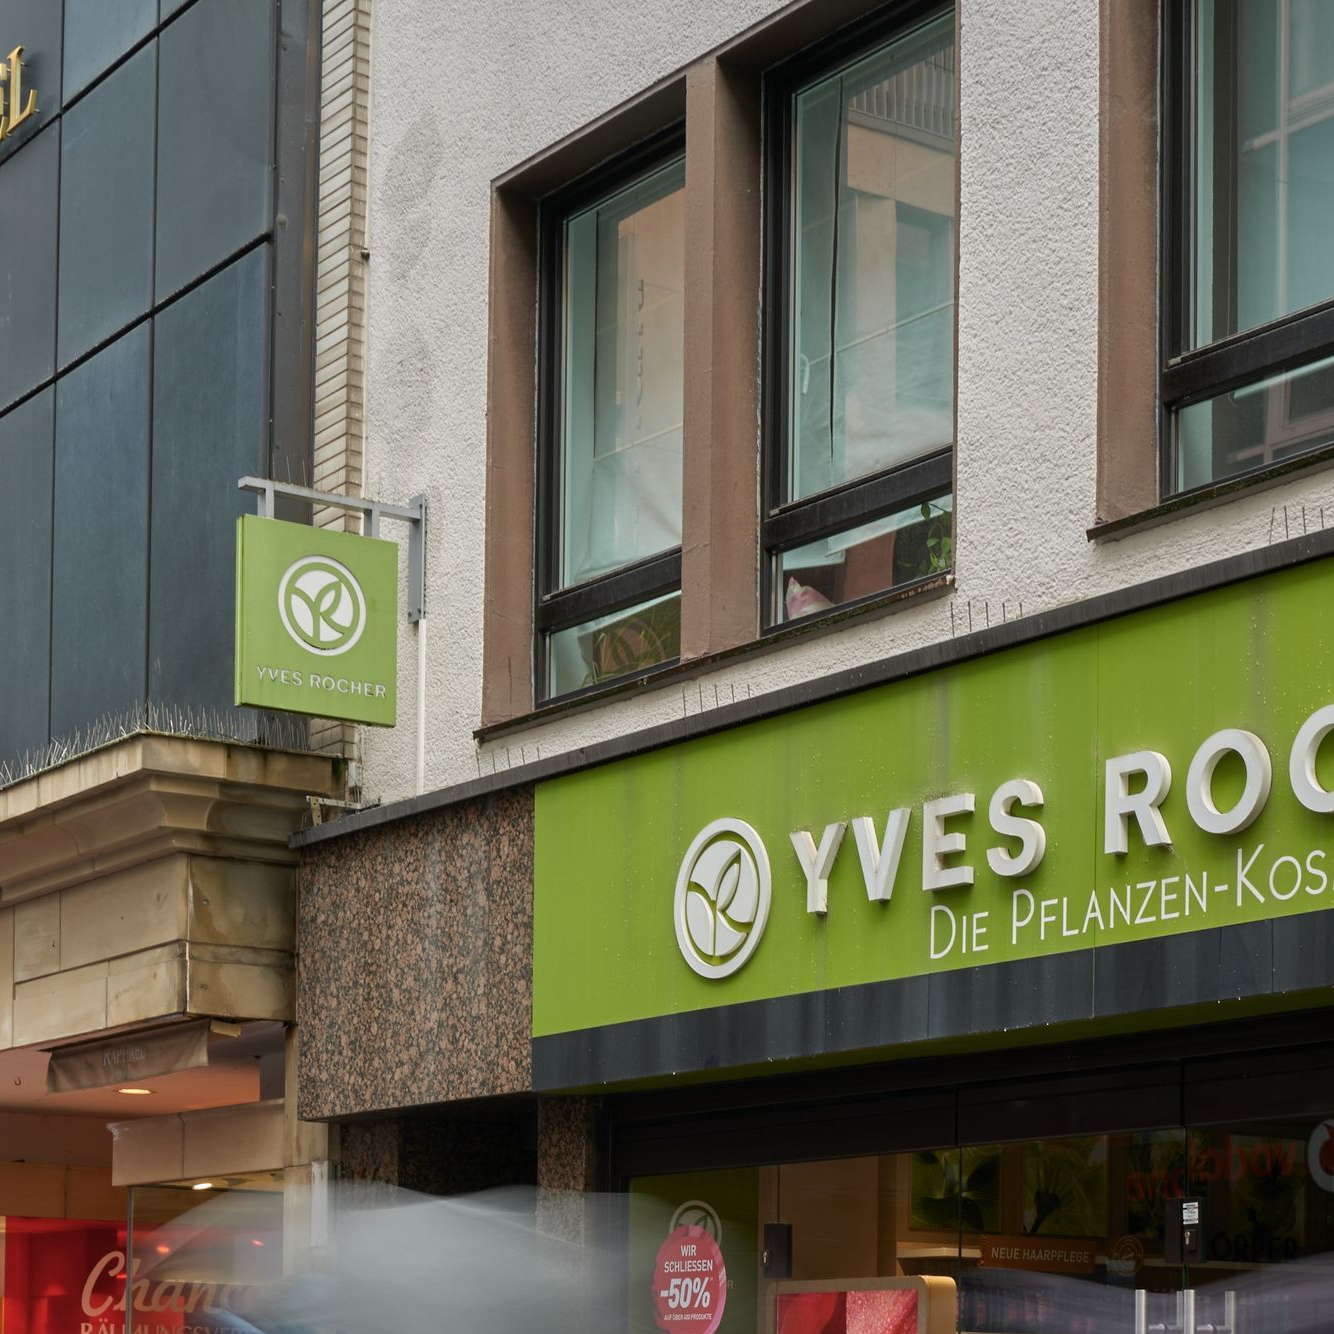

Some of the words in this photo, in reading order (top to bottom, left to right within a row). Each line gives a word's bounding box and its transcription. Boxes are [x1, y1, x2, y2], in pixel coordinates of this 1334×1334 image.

[257, 665, 303, 687] YVES
[310, 674, 387, 699] ROCHER
[789, 779, 1046, 915] YVES
[680, 1244, 697, 1257] WIR
[990, 1247, 1020, 1260] NEUE
[1022, 1249, 1090, 1264] HAARPFLEGE
[663, 1259, 713, 1273] SCHLIESSEN
[659, 1276, 711, 1309] -50%
[690, 1312, 713, 1321] PRODUKTE
